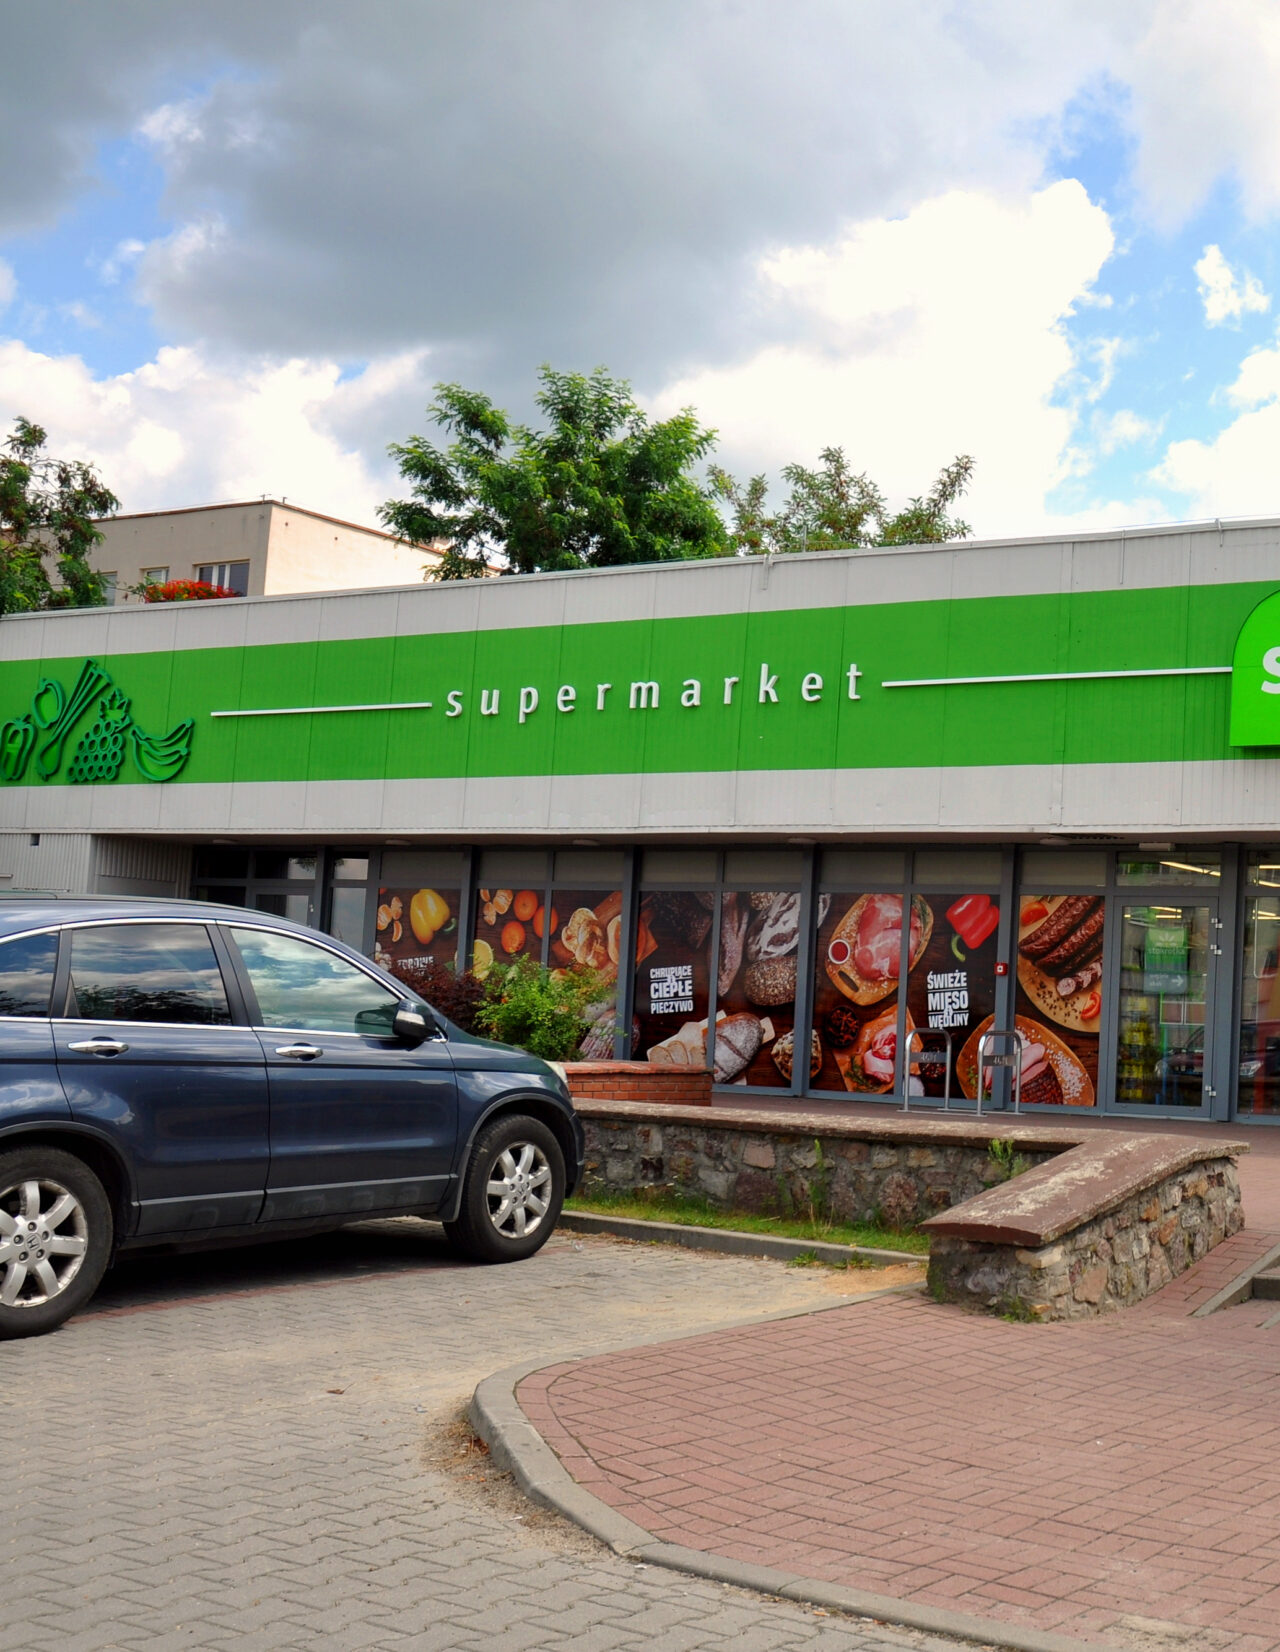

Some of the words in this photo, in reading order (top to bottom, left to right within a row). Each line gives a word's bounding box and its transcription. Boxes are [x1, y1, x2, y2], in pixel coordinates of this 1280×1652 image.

[446, 663, 862, 723] supermarket
[927, 969, 967, 989] ŚWIEŻE
[650, 980, 693, 999] CIEPŁE
[651, 1000, 693, 1014] PIECZYWO
[928, 1013, 969, 1030] WĘDLINY
